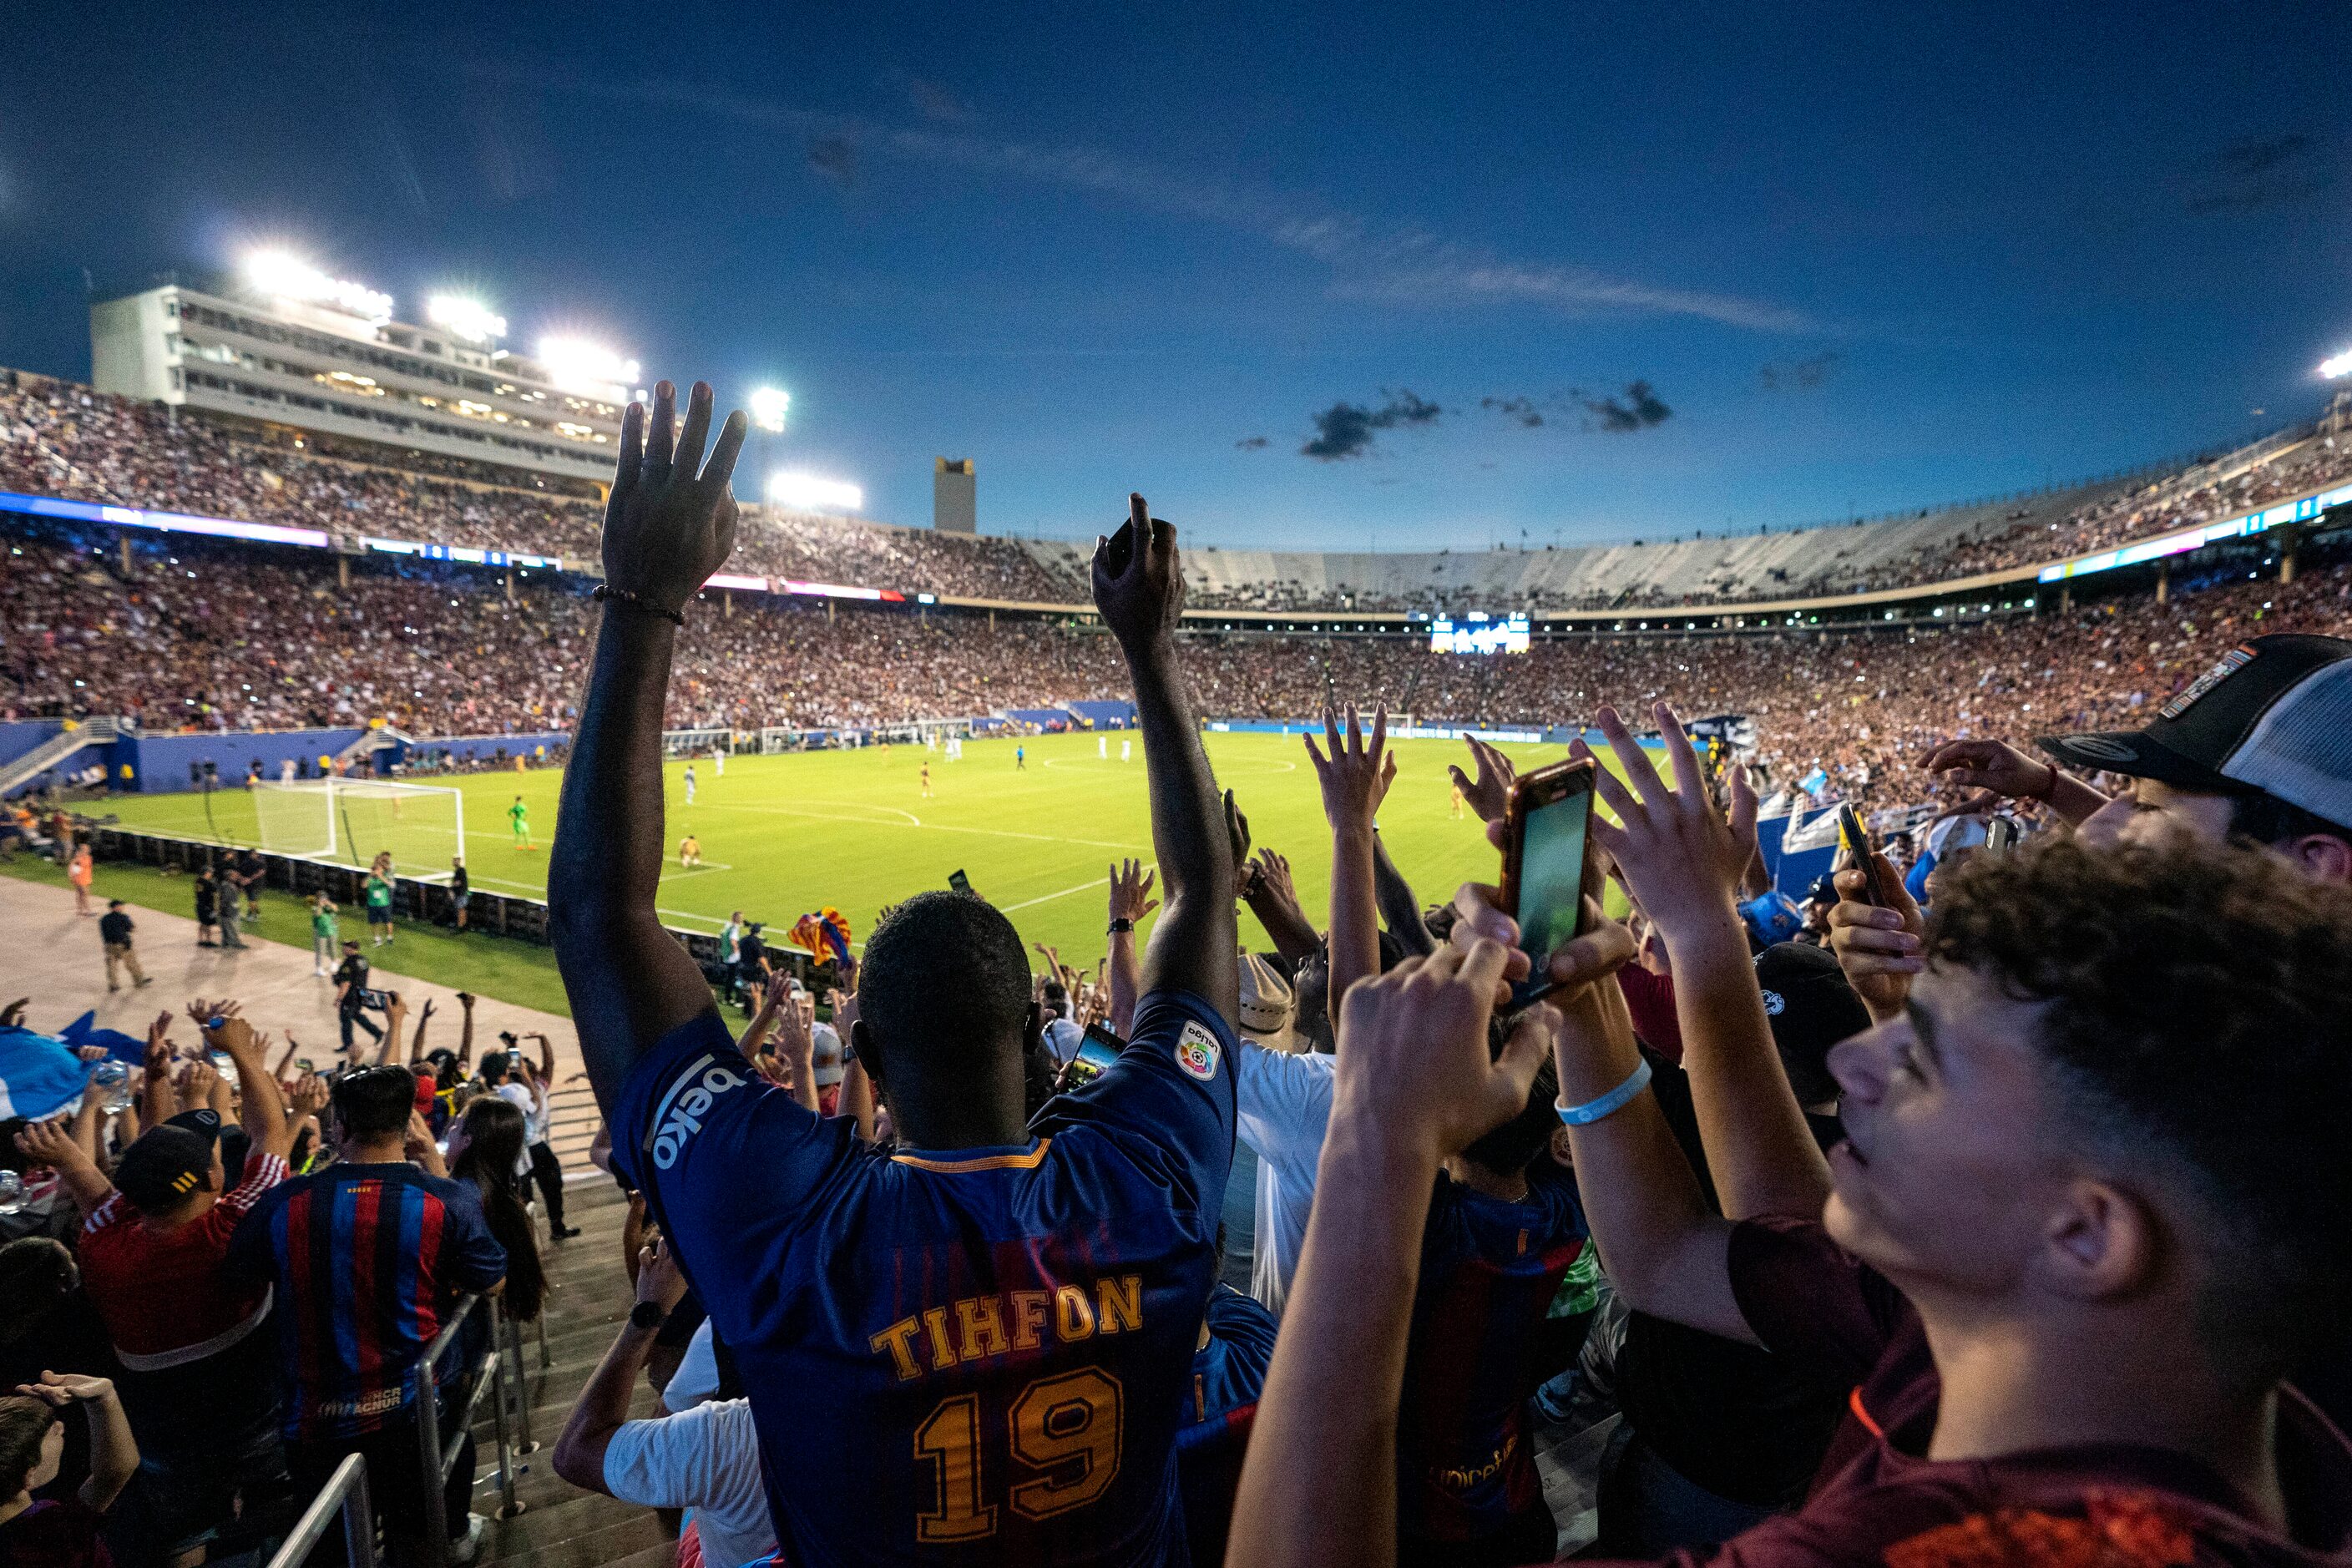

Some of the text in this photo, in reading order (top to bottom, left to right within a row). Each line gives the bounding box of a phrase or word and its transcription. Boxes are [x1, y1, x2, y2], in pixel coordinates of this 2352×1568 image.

[653, 1067, 747, 1170] beko
[868, 1273, 1143, 1381] TIHFON
[913, 1365, 1125, 1543] 19
